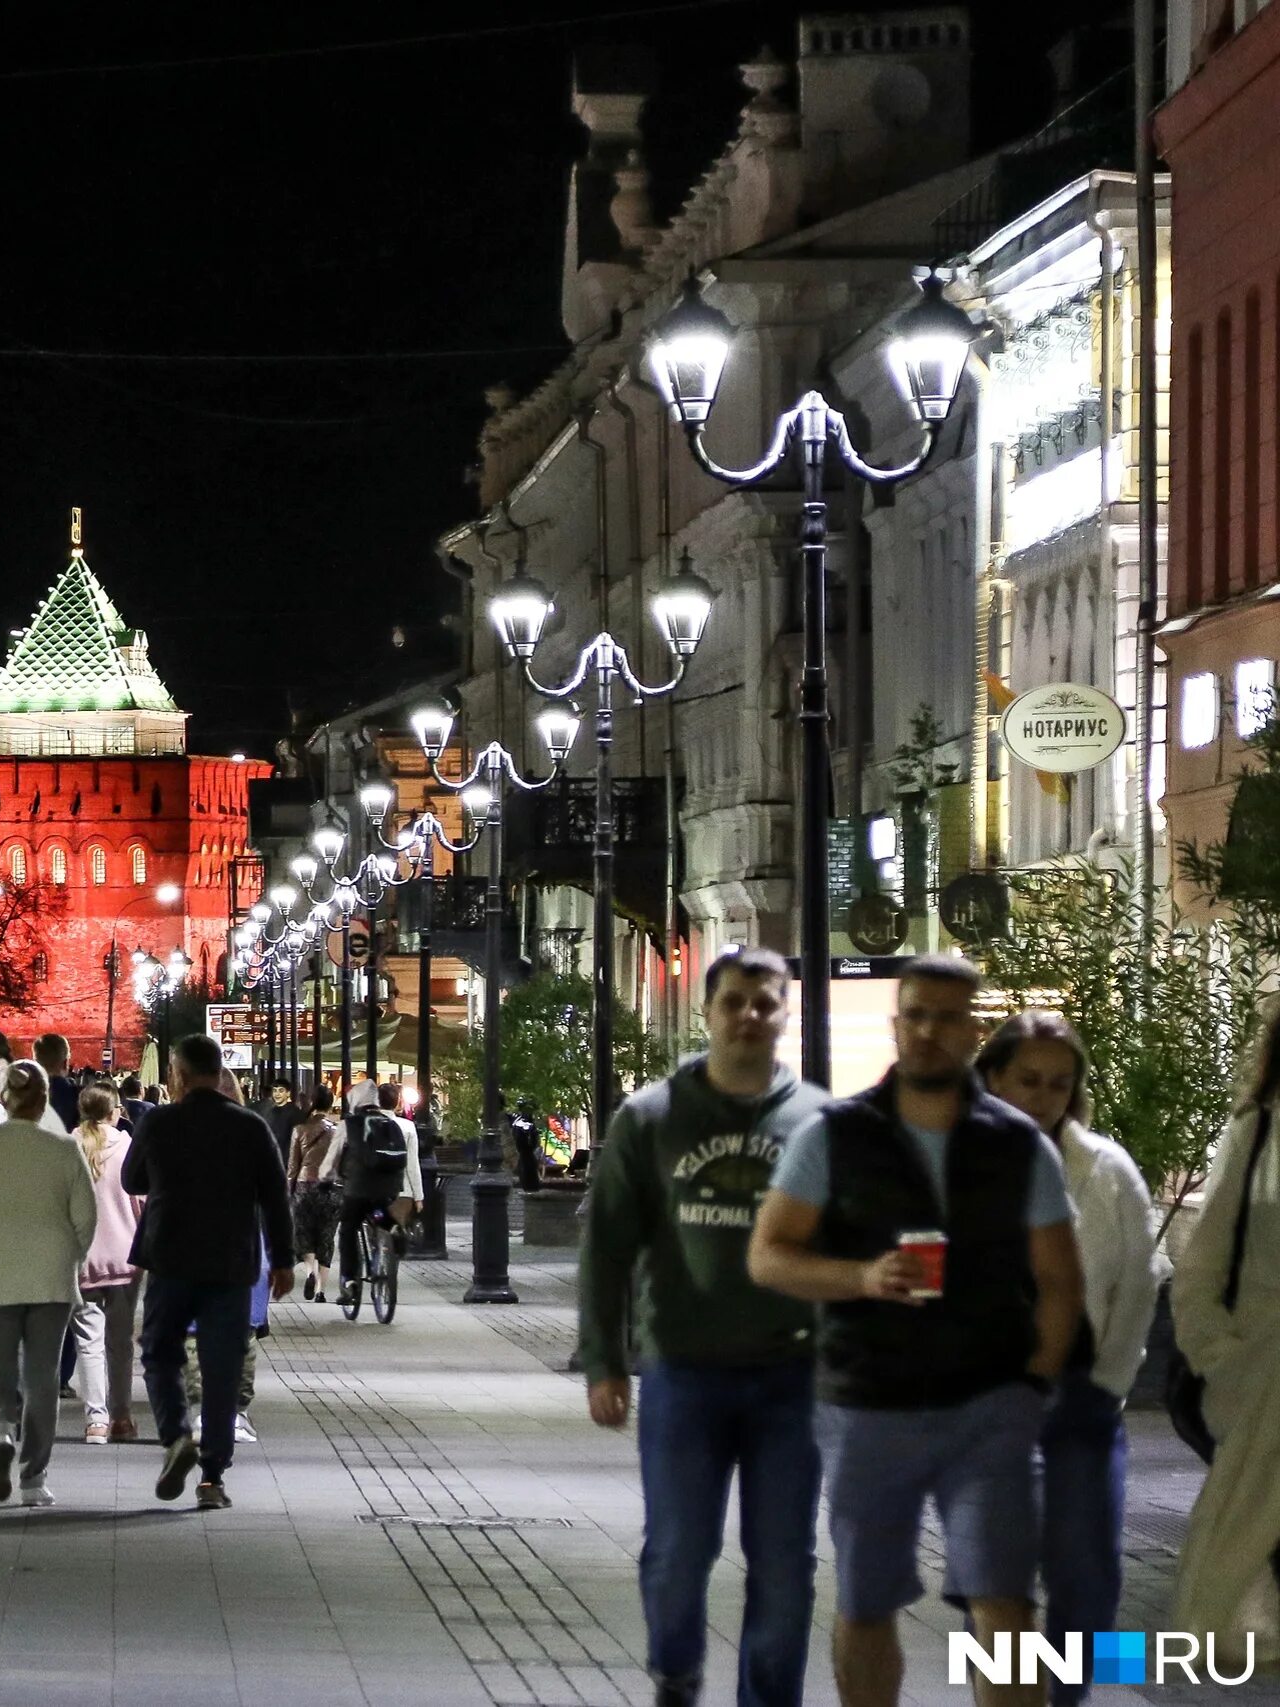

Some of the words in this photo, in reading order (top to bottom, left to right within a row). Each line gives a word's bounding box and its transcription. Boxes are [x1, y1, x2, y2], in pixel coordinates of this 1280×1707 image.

[1023, 719, 1108, 738] НОТАРИУС
[673, 1133, 744, 1179] YELLOW
[747, 1134, 782, 1165] STO
[679, 1203, 754, 1228] NATIONAL
